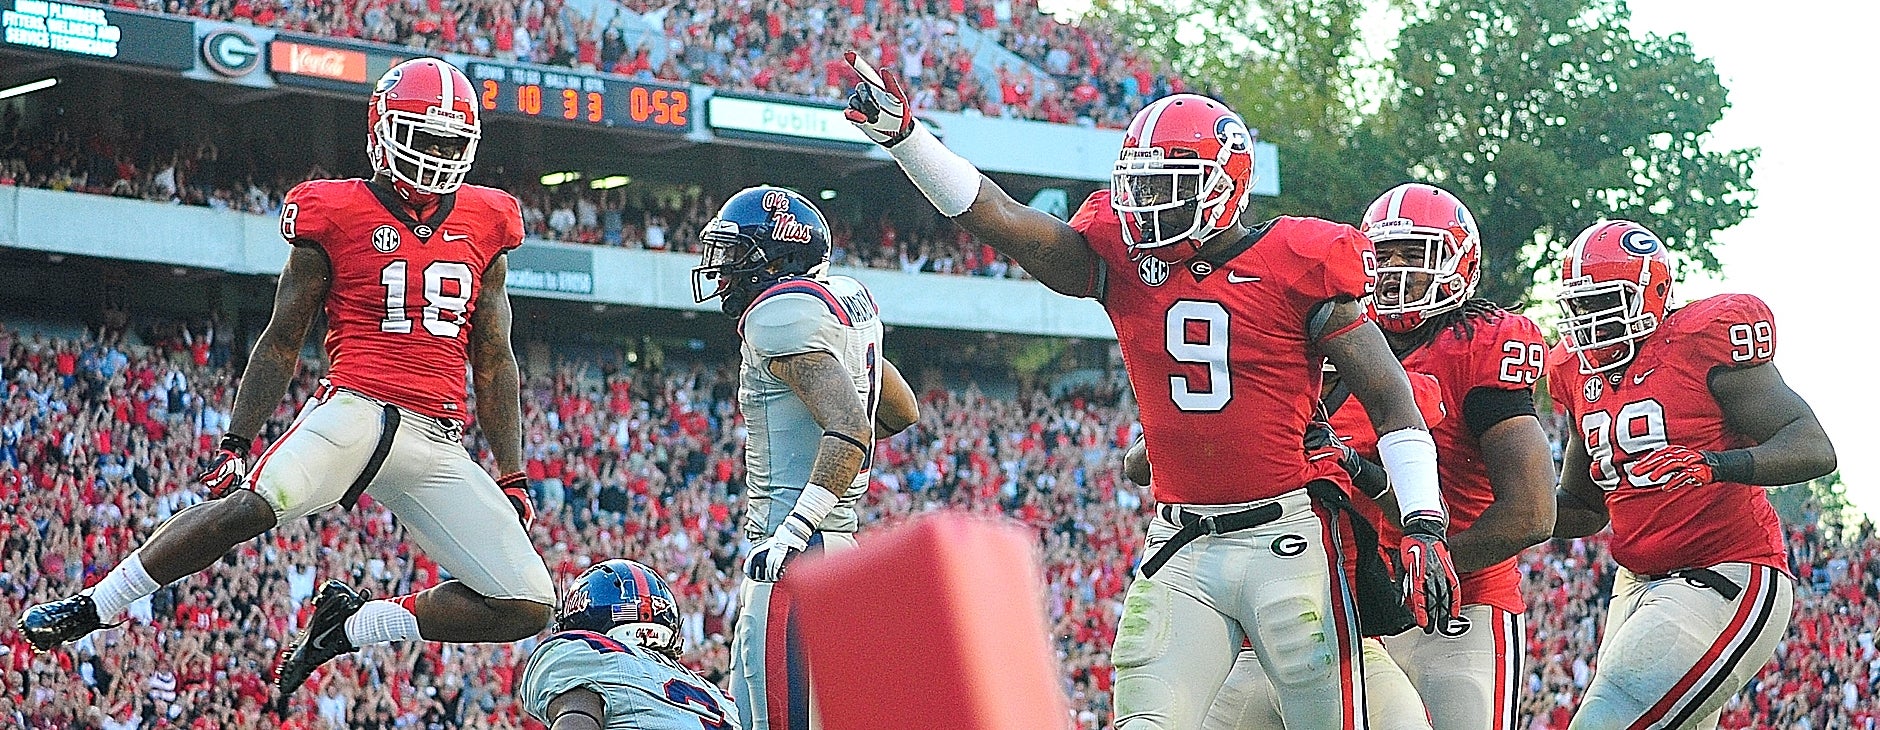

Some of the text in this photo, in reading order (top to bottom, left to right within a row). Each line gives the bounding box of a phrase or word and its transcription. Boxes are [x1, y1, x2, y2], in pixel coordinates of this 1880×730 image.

[208, 31, 259, 72] G
[482, 79, 498, 110] 2
[518, 85, 541, 115] 10
[562, 89, 578, 119] 3
[587, 92, 602, 122] 3
[762, 190, 789, 213] Ole
[375, 228, 398, 249] SEC
[772, 211, 812, 244] Miss
[1622, 230, 1658, 255] G
[1141, 256, 1168, 284] SEC
[1192, 262, 1211, 275] G
[1361, 249, 1378, 294] 9
[380, 259, 473, 337] 18
[1165, 298, 1232, 413] 9
[1729, 320, 1773, 362] 99
[1499, 340, 1545, 385] 29
[1581, 398, 1676, 492] 99
[1270, 533, 1309, 558] G
